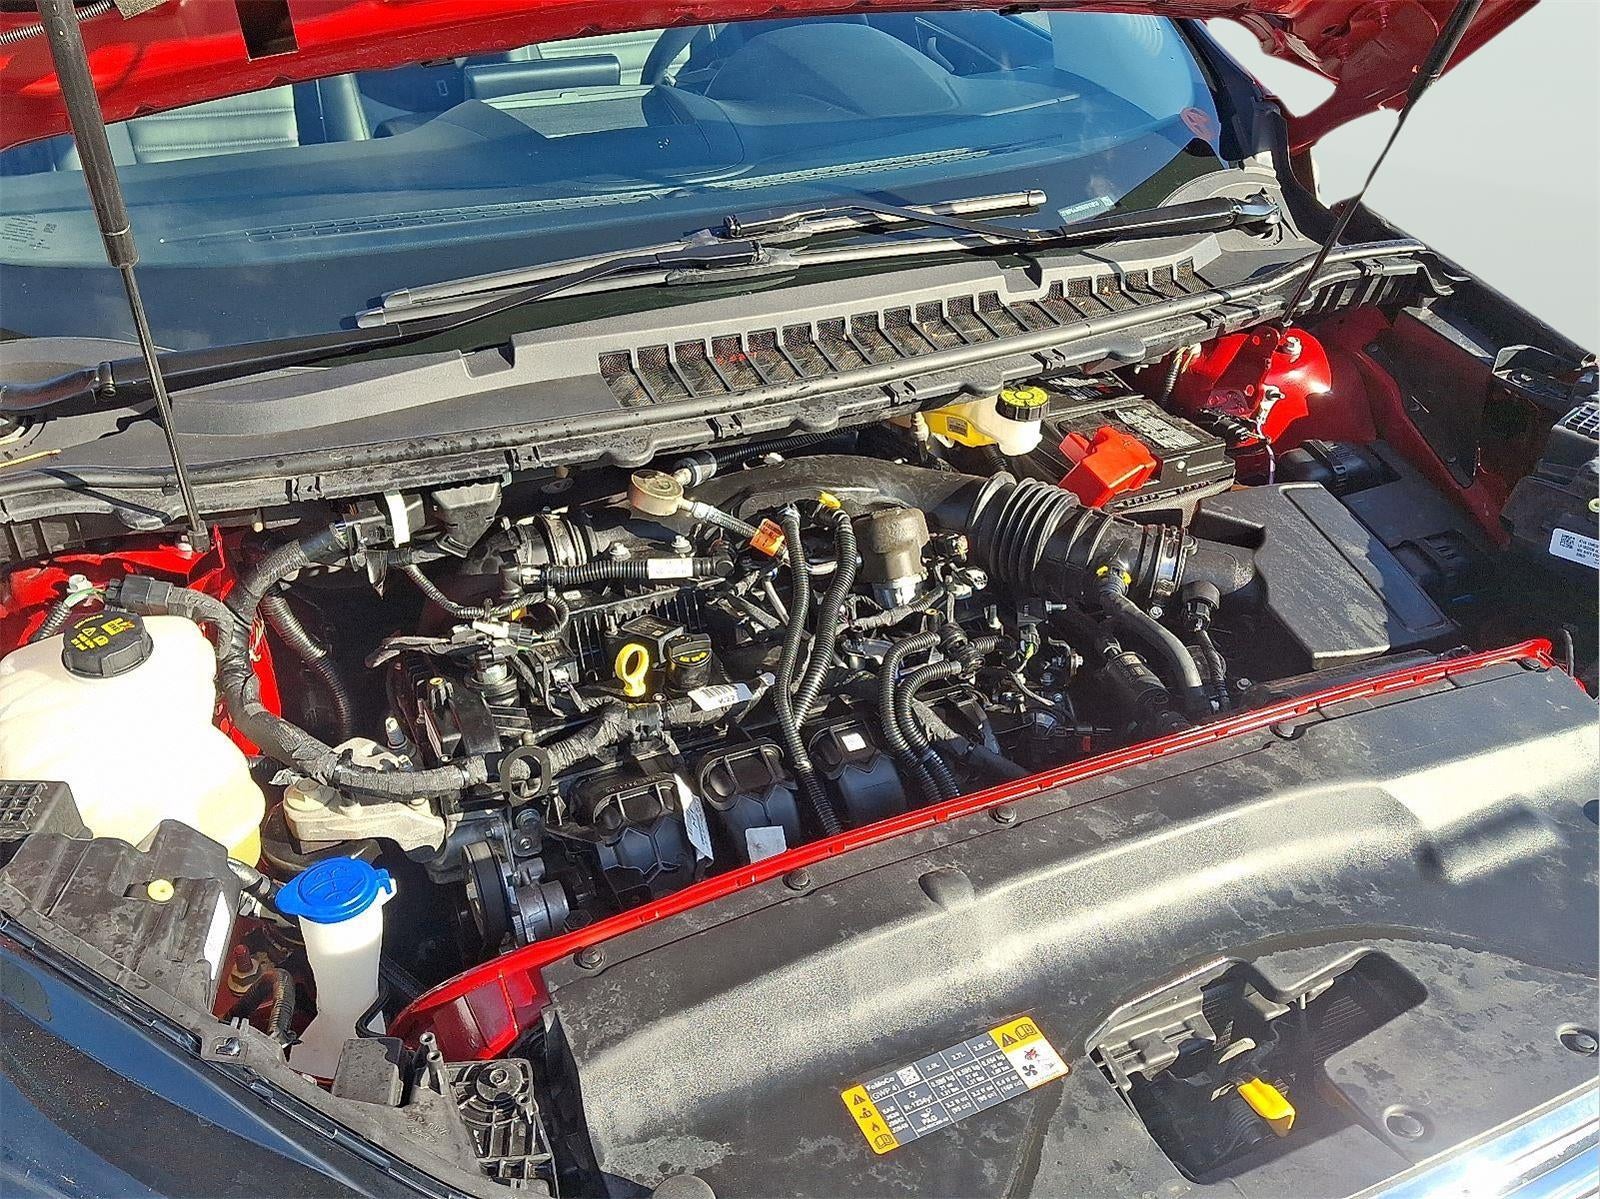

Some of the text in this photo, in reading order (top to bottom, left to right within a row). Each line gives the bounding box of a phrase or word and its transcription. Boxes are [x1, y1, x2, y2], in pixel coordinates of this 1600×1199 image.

[951, 1052, 966, 1060] 2.7L
[866, 1077, 895, 1092] FoMoCo
[870, 1083, 900, 1102] (GWP 4)
[904, 1094, 934, 1111] R-1234yf
[921, 1115, 938, 1126] PAG
